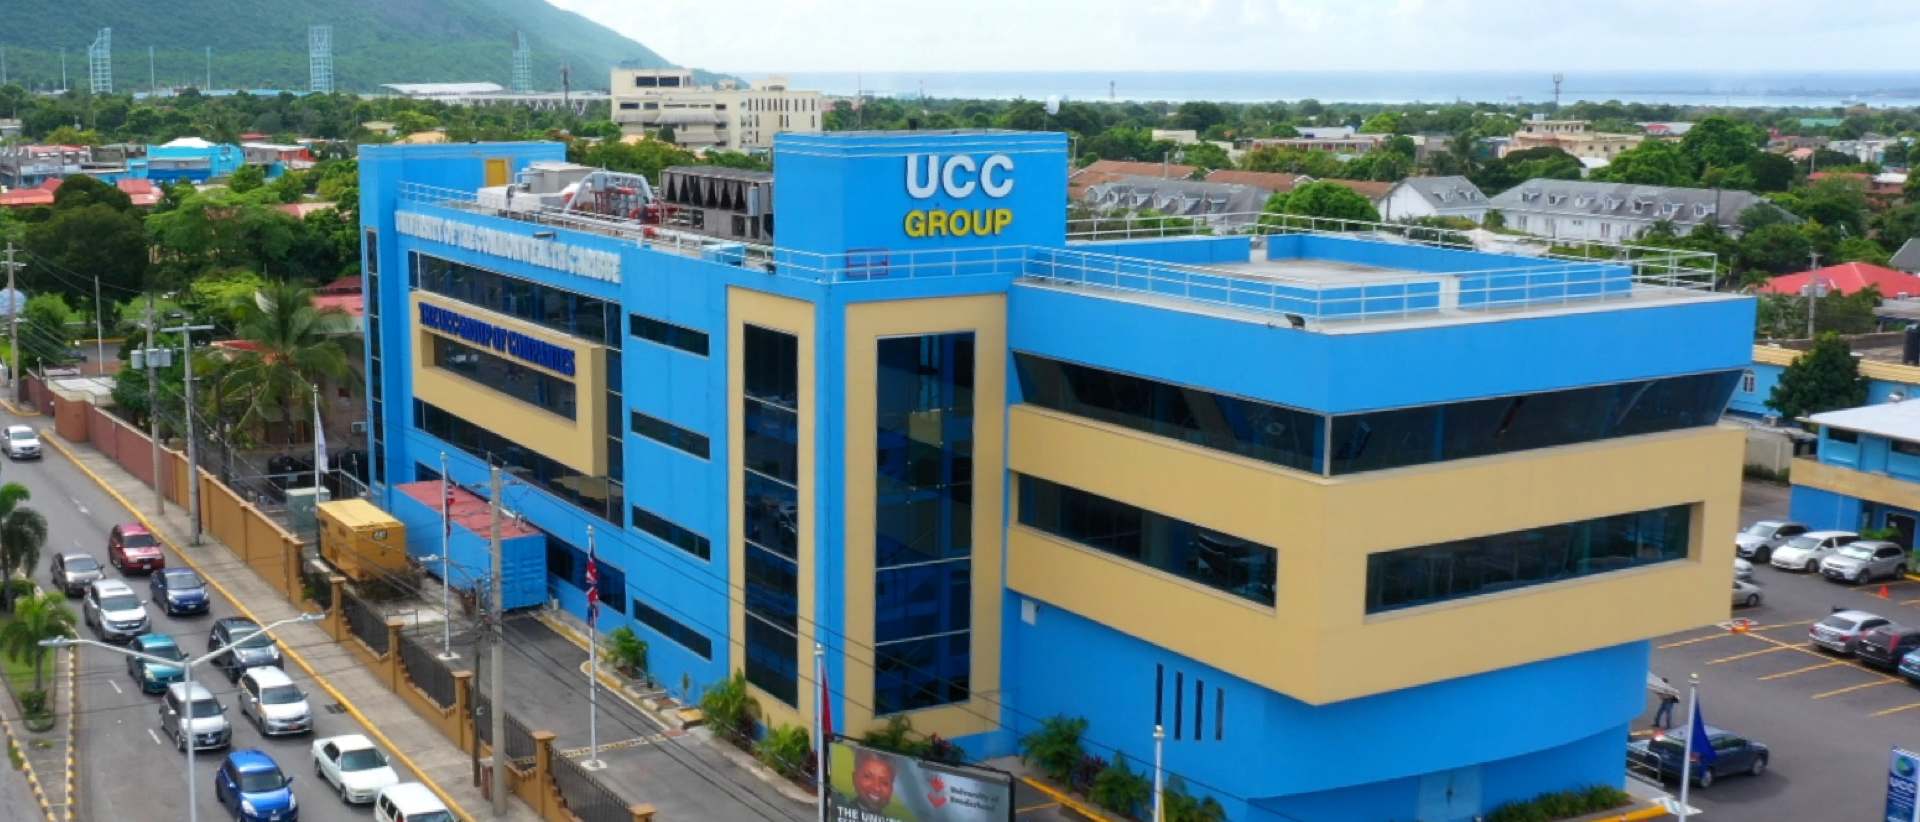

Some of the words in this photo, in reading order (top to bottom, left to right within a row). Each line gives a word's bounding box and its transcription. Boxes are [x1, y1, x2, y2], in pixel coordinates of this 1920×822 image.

[906, 152, 1014, 199] UCC
[904, 208, 1013, 237] GROUP
[419, 302, 439, 329] THE
[460, 313, 492, 347] GROUP
[493, 323, 507, 352] OF
[837, 806, 859, 819] THE
